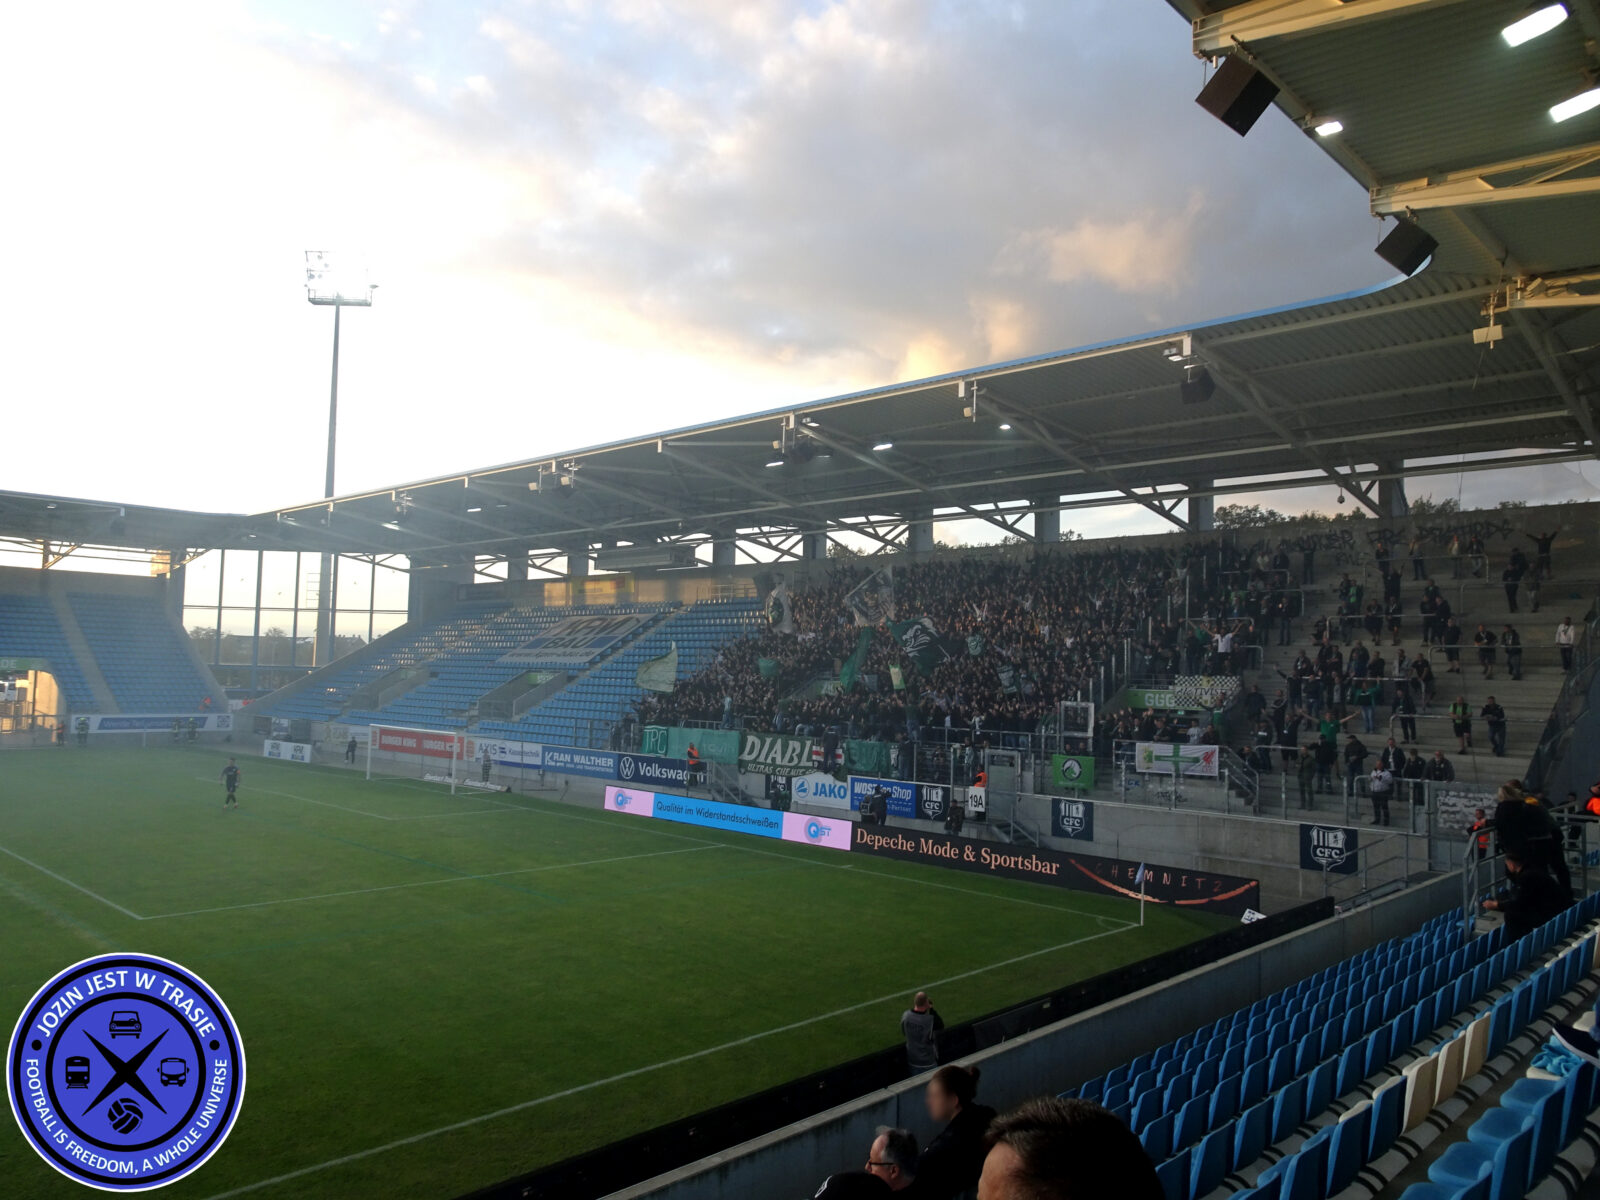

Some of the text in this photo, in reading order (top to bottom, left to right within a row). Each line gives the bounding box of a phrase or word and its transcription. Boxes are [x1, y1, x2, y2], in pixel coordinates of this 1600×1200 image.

[545, 637, 596, 649] BAU
[545, 751, 571, 765] KRAN
[573, 754, 614, 768] WALTHER
[639, 762, 705, 784] Volkswagn
[813, 782, 848, 799] JAKO
[892, 786, 912, 801] Shop
[925, 801, 940, 810] CFC
[969, 794, 984, 809] 19A
[656, 801, 779, 830] Qualität im Widerstandsschweißen
[1063, 817, 1081, 827] CFC
[856, 828, 1060, 876] Depeche Mode & Sportsbar
[1316, 847, 1341, 859] CFC
